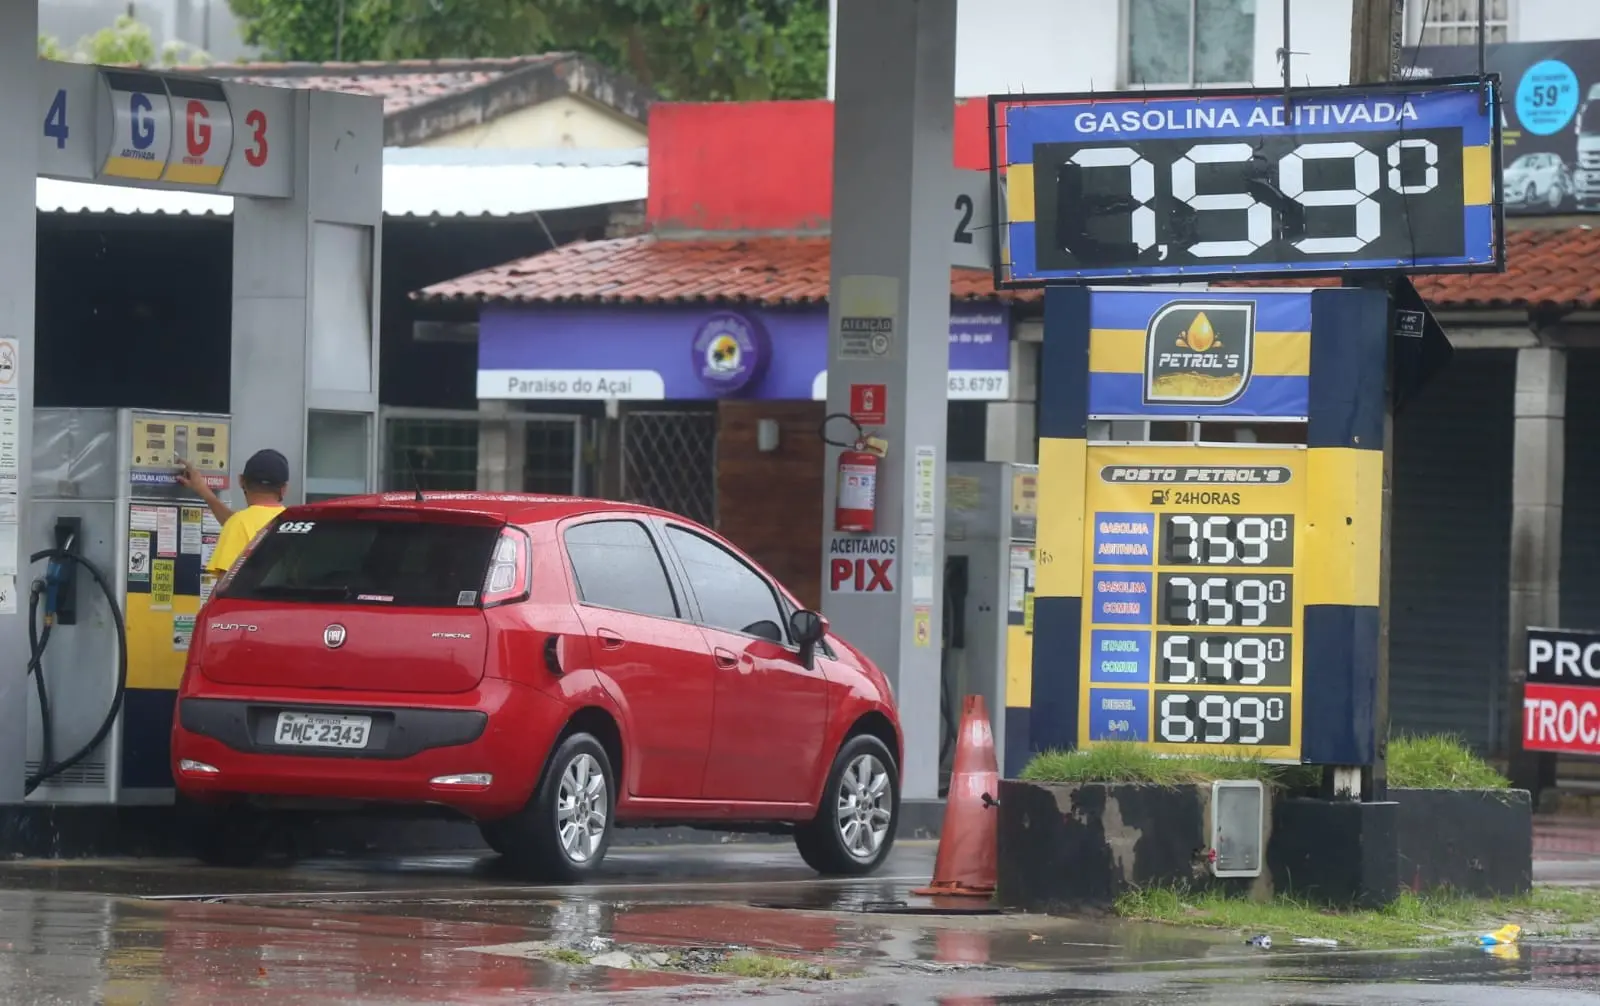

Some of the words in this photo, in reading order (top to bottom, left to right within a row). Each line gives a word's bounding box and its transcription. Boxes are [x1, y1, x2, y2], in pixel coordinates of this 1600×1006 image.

[43, 89, 69, 149] 4
[130, 92, 155, 150] G
[1074, 106, 1240, 134] GASOLINA
[1247, 100, 1419, 129] ADITIVADA
[186, 100, 212, 156] G
[244, 109, 269, 167] 3
[953, 194, 974, 244] 2
[1159, 353, 1240, 369] PETROL'S
[572, 376, 593, 393] do
[1111, 468, 1177, 481] POSTO
[1184, 469, 1280, 483] PETROL'S
[1175, 491, 1241, 506] 24HORAS
[1099, 522, 1149, 535] GASOLINA
[829, 537, 896, 555] ACEITAMOS
[1098, 543, 1149, 556] ADITIVADA
[831, 558, 894, 592] PIX
[1098, 580, 1147, 594] GASOLINA
[1103, 602, 1140, 614] COMUM
[211, 623, 258, 632] PUNTO
[328, 630, 342, 642] FIAT
[1101, 640, 1140, 653] ETANOL
[1101, 661, 1138, 673] COMUM
[1101, 697, 1136, 711] DIESEL
[1523, 697, 1600, 745] TROC
